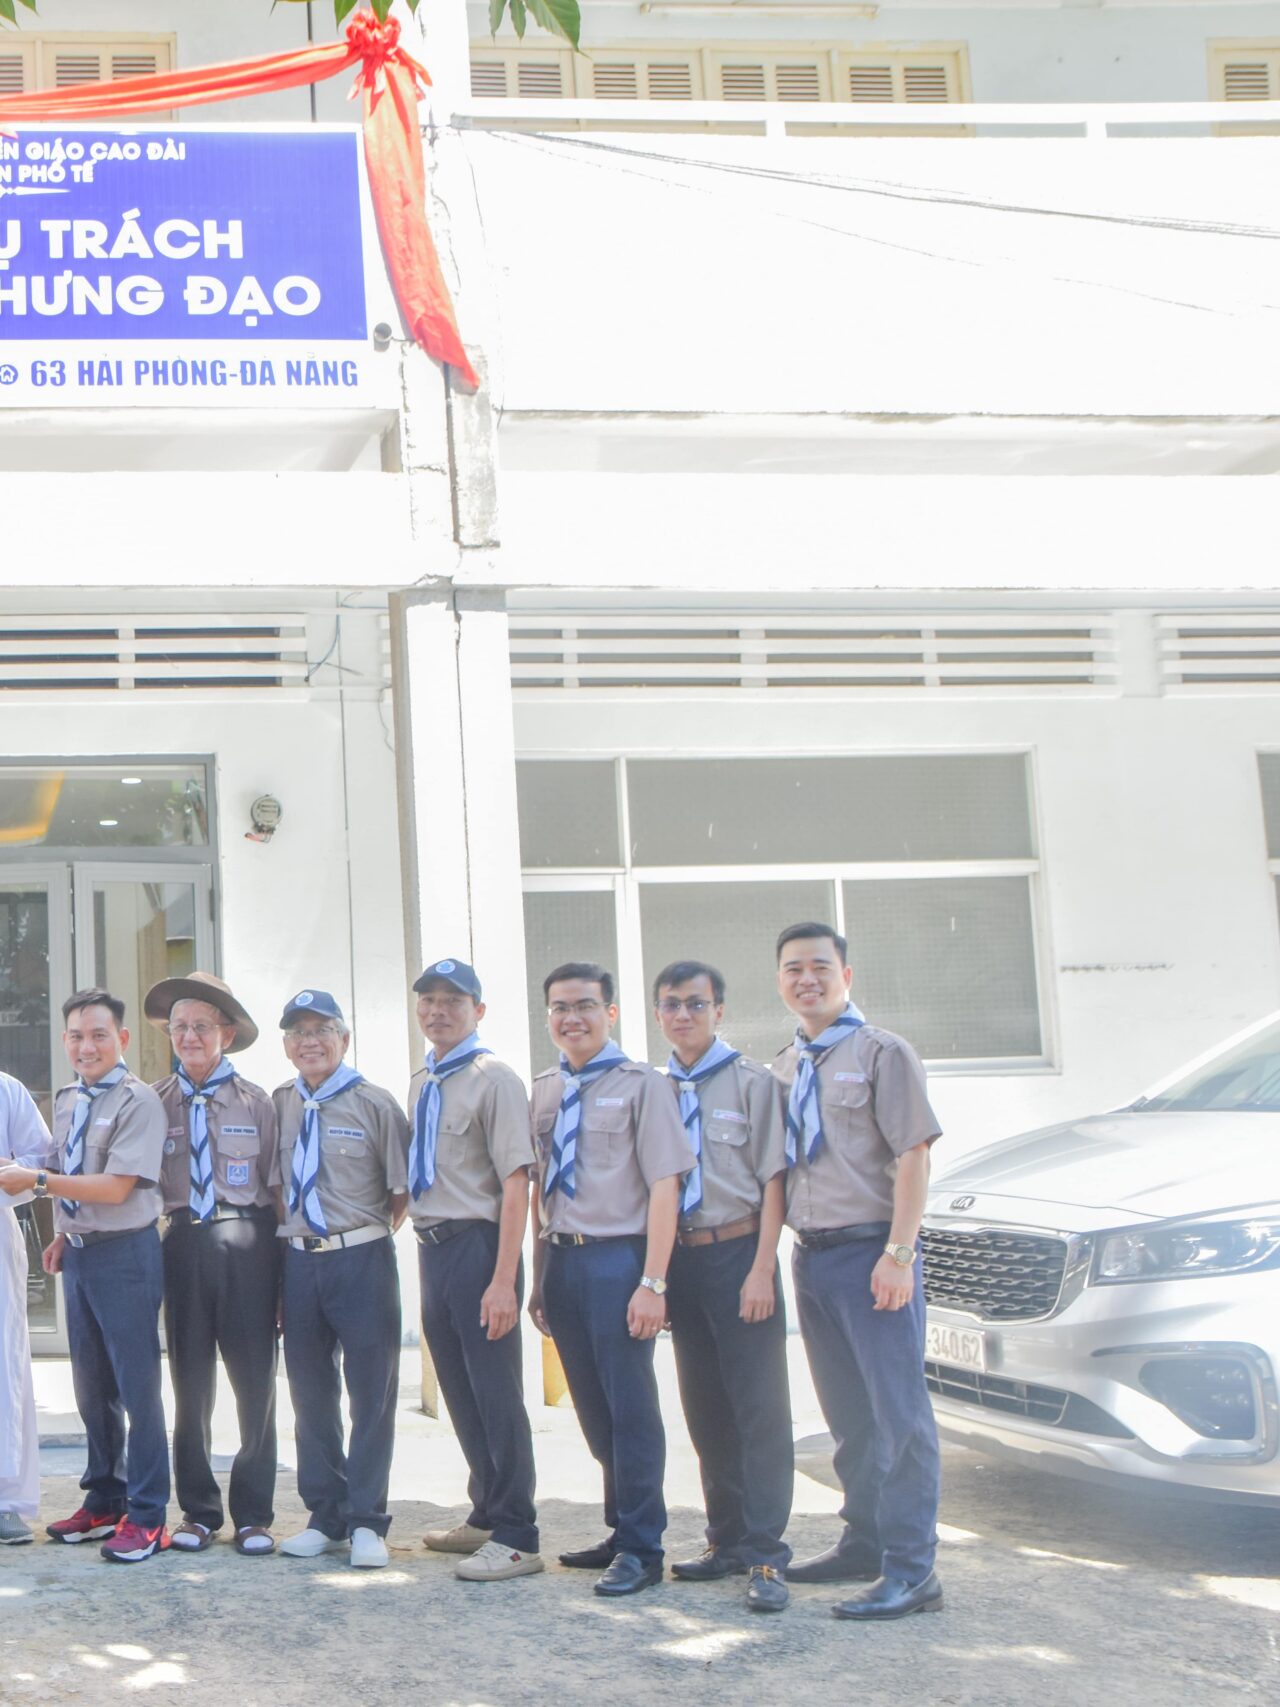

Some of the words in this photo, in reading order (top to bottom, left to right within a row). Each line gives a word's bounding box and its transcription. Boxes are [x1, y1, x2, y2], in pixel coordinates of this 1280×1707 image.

[25, 138, 85, 161] GIÁO
[89, 141, 142, 161] CAO
[147, 138, 186, 161] ĐÀI
[70, 159, 97, 183] TẾ
[40, 207, 244, 260] TRÁCH
[183, 275, 321, 327] ĐẠO
[30, 359, 67, 387] 63
